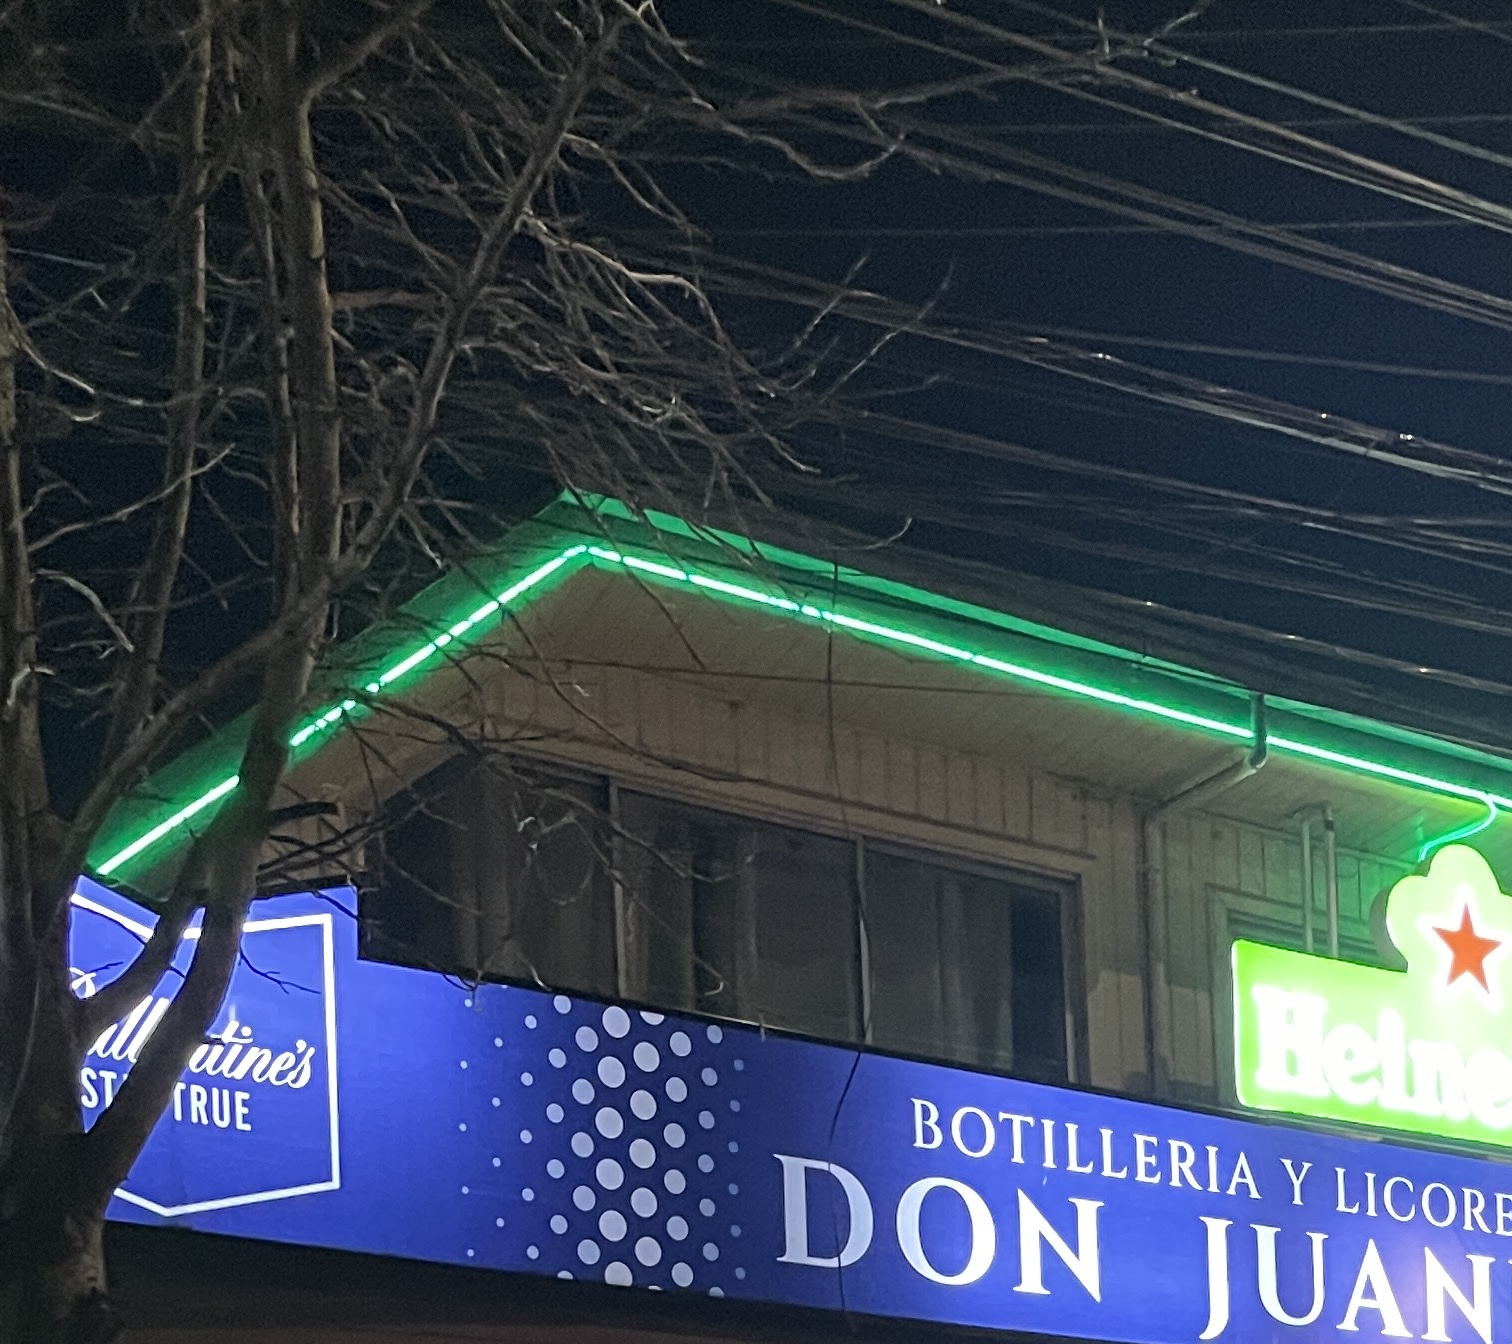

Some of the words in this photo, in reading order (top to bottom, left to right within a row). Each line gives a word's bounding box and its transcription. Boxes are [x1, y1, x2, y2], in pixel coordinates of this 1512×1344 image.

[173, 1081, 252, 1131] TRUE
[911, 1097, 1262, 1200] BOTILLERIA
[1280, 1158, 1313, 1205] Y
[774, 1153, 1105, 1303] DON
